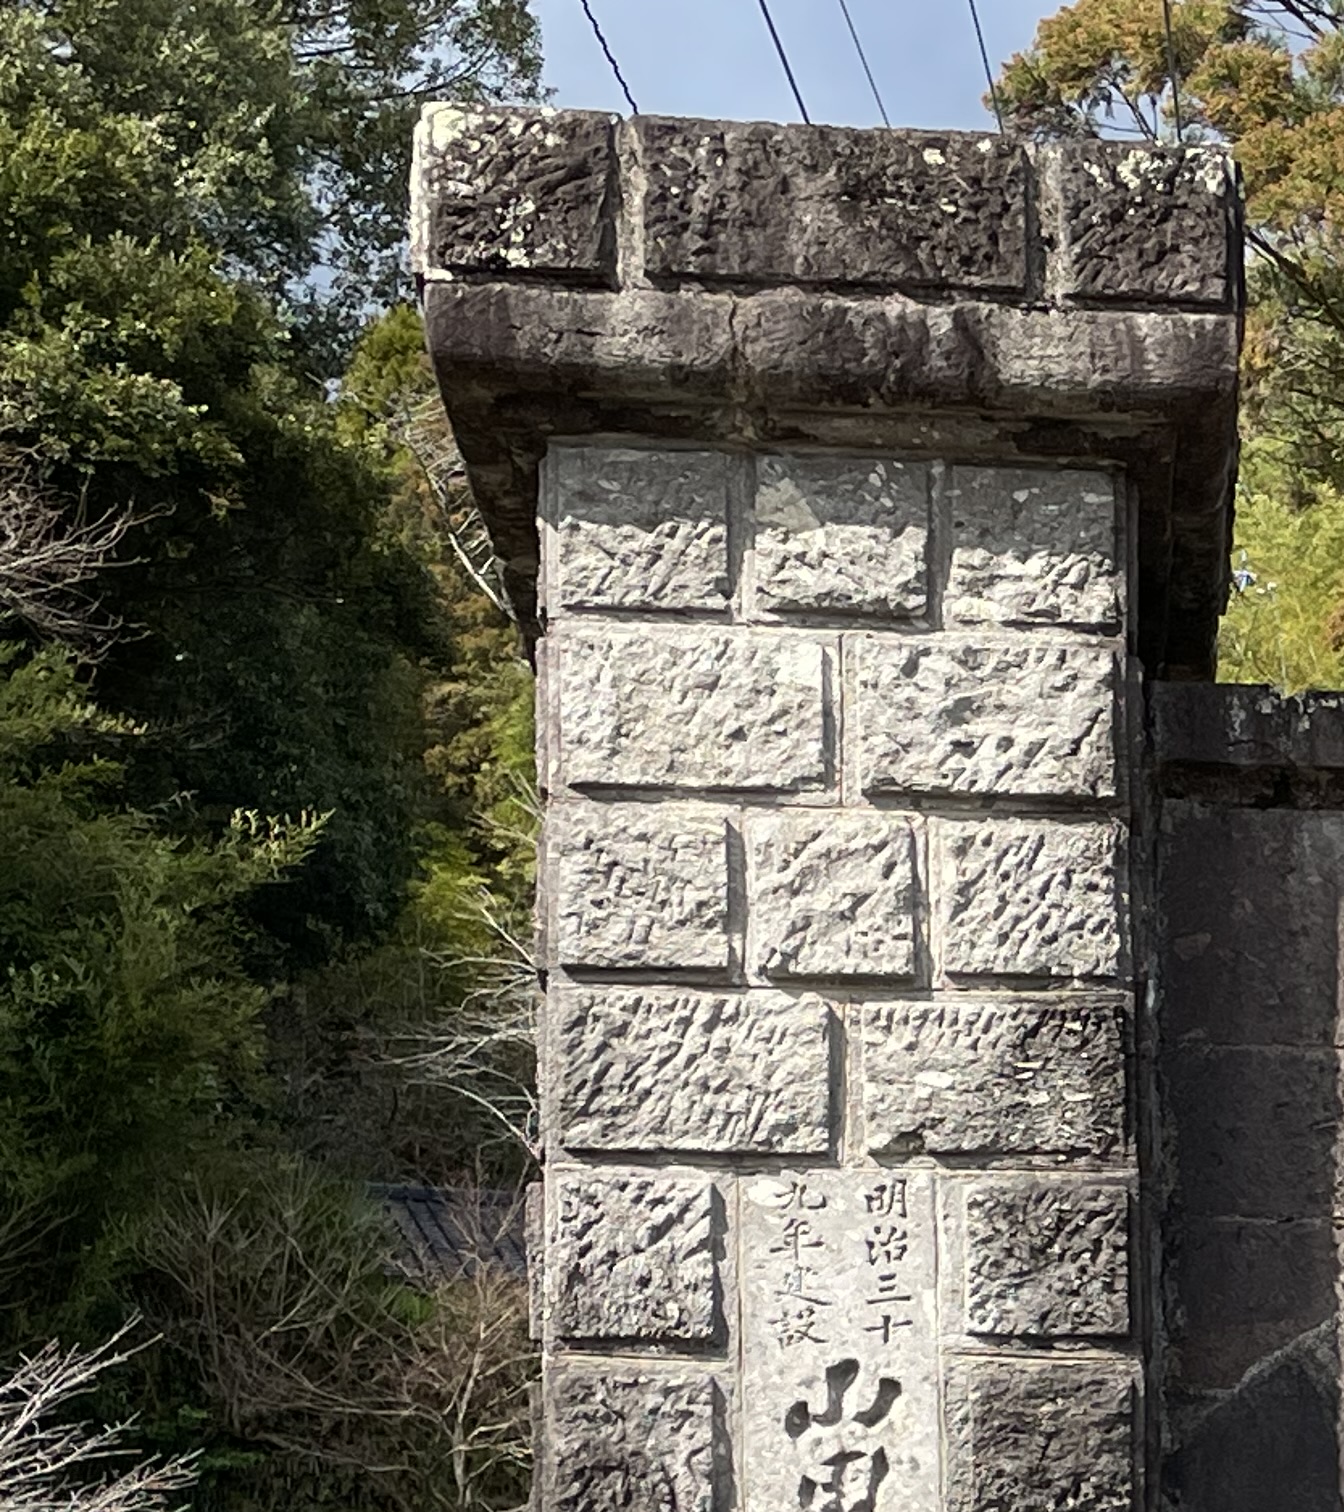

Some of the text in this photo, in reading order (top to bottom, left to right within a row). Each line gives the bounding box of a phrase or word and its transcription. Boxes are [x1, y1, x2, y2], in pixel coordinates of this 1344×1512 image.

[767, 1180, 833, 1349] 九年建設
[863, 1178, 914, 1344] 明治三十
